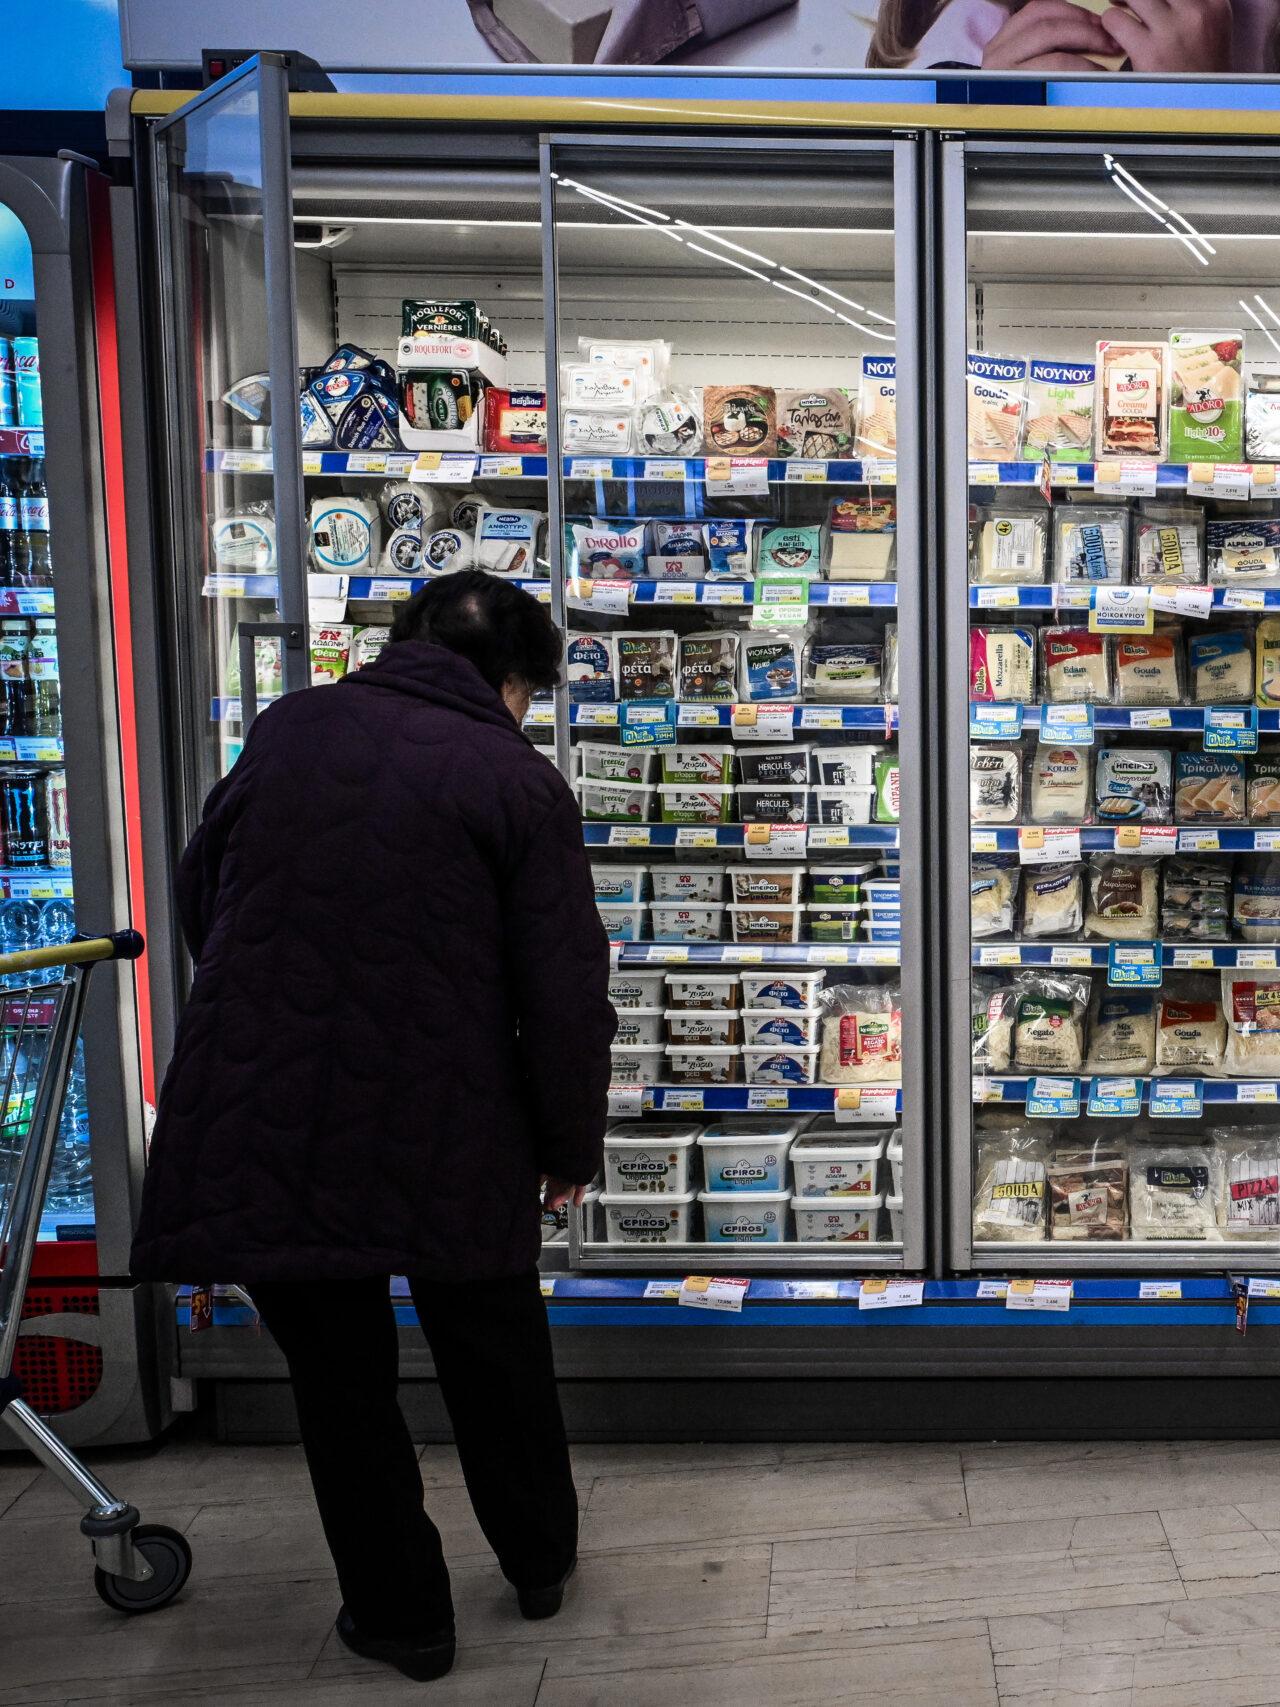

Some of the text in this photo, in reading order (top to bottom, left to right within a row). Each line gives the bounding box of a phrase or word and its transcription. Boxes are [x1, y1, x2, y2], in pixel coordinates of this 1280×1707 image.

[411, 305, 467, 321] ROQUEFORT
[417, 323, 462, 331] VERNIÈRES
[414, 344, 452, 354] ROQUEFORT
[968, 361, 1022, 377] NOYNOY
[1034, 367, 1091, 381] NOYNOY
[1117, 381, 1148, 392] ADORO
[974, 386, 1009, 400] Gouda
[1048, 388, 1075, 400] Light
[511, 397, 542, 406] Bergader
[1117, 401, 1147, 410] Creamy
[1187, 399, 1223, 413] ADORO
[585, 536, 638, 551] DiRollo
[1083, 528, 1103, 562] GOUDA
[1162, 530, 1182, 572] GOUDA
[1098, 612, 1145, 620] ΝΟΙΚΟΚΥΡΙΟΥ
[573, 651, 601, 660] Φέτα
[748, 648, 777, 657] VIOFAST
[622, 663, 651, 676] φέτα
[682, 663, 712, 676] φέτα
[996, 644, 1004, 688] Mozzarella
[1063, 666, 1087, 674] Edam
[1133, 666, 1161, 675] Gouda
[1206, 662, 1232, 673] Gouda
[758, 705, 792, 713] Συμφέρει!
[758, 762, 791, 773] HERCULES
[1116, 763, 1155, 771] ΗΠΕΙΡΟΣ
[1182, 762, 1238, 775] Τρικαλινό
[756, 799, 790, 808] HERCULES
[1140, 827, 1175, 835] Συμφέρει!
[769, 989, 788, 998] Φέτα
[1256, 992, 1270, 1000] MIX
[770, 1026, 790, 1034] Φέτα
[1174, 1028, 1202, 1038] Gouda
[770, 1062, 790, 1070] Φέτα
[622, 1163, 664, 1171] EPIROS
[998, 1182, 1039, 1197] GOUDA
[1238, 1177, 1274, 1198] PIZZA
[1237, 1199, 1254, 1211] MIX
[623, 1219, 665, 1227] EPIROS
[723, 1225, 762, 1233] EPIROS
